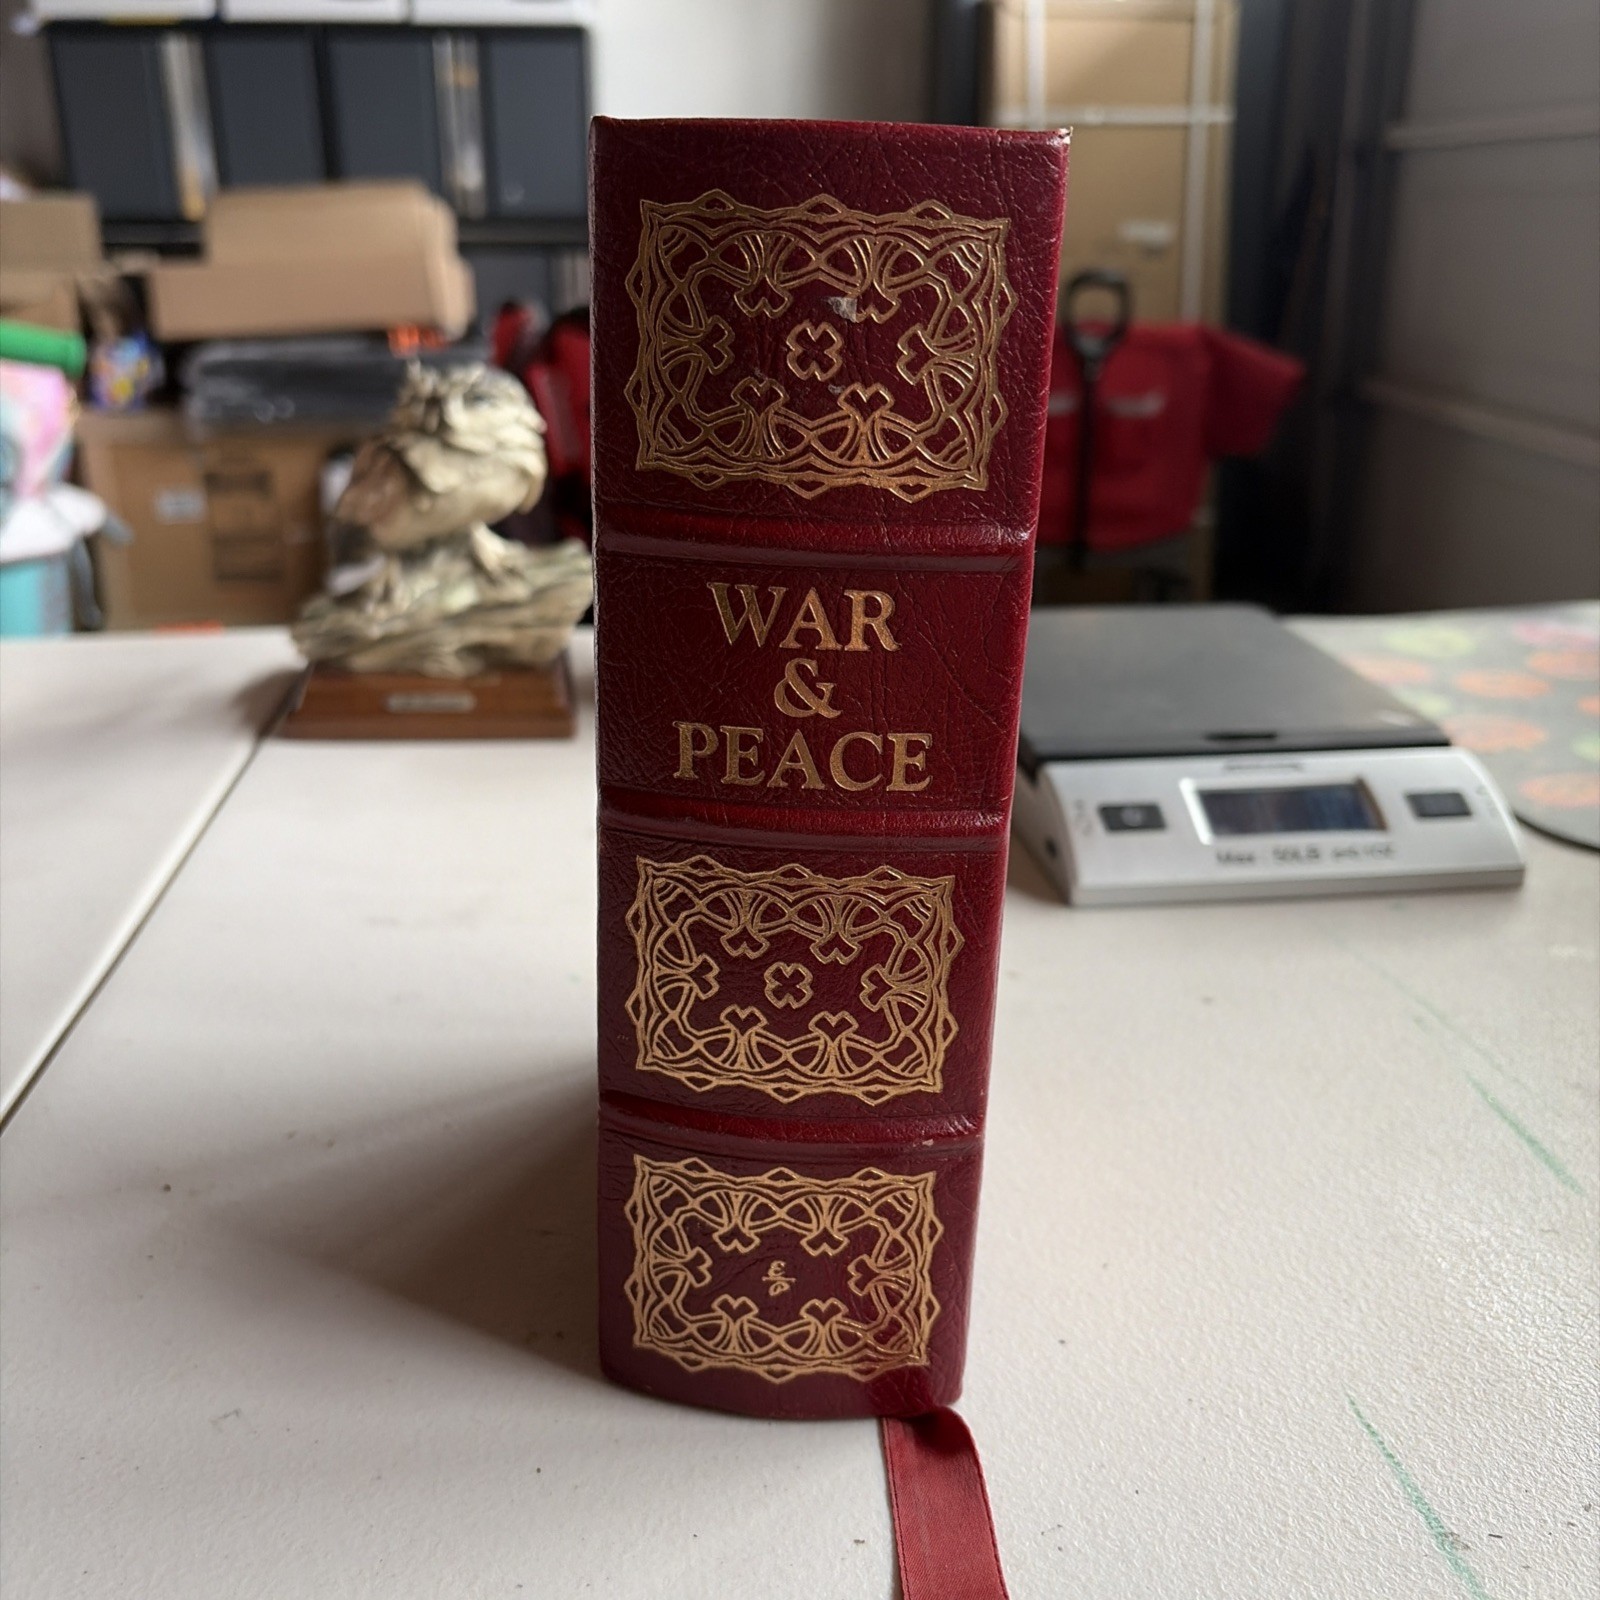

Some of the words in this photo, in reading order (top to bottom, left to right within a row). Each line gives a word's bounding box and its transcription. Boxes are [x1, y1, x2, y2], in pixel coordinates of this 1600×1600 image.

[707, 582, 902, 651] WAR
[774, 657, 842, 719] &
[672, 721, 933, 792] PEACE
